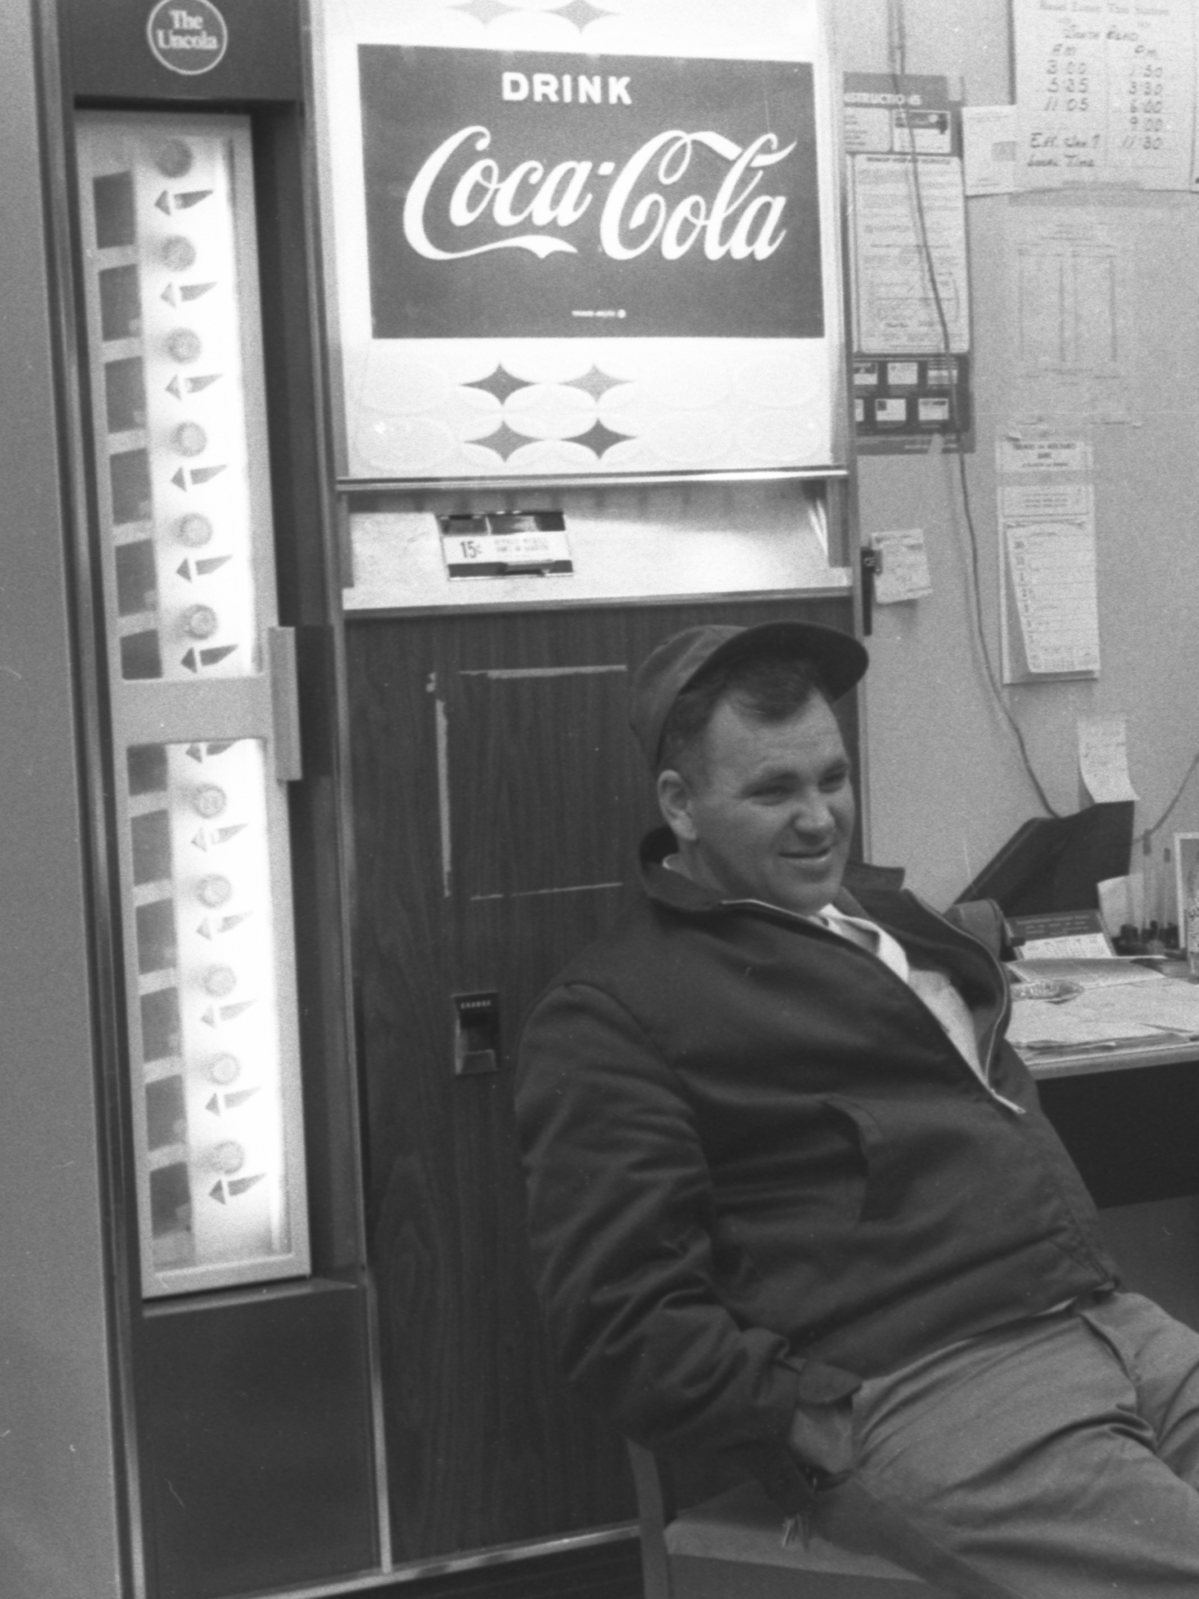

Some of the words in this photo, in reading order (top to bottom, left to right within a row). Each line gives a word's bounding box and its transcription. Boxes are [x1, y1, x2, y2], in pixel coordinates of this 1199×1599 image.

[168, 9, 204, 30] The
[156, 28, 219, 50] Uncola
[502, 71, 633, 105] DRINK
[403, 124, 799, 262] Coca-Cola
